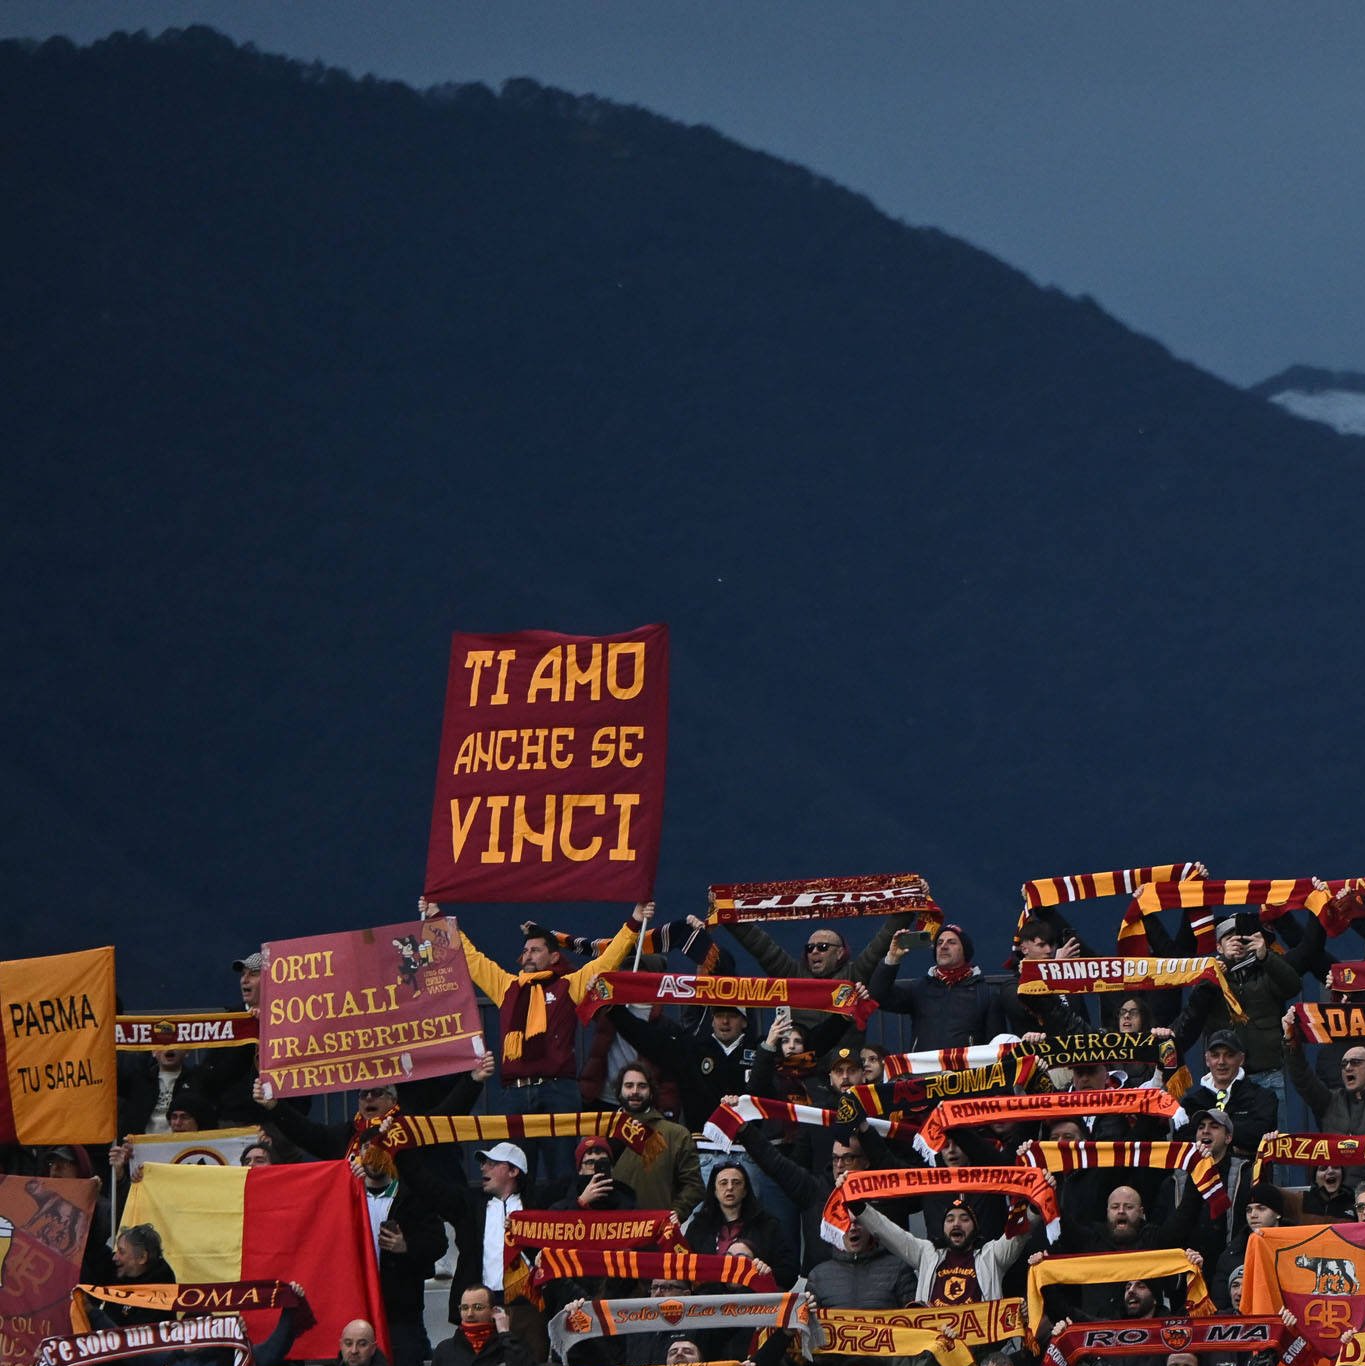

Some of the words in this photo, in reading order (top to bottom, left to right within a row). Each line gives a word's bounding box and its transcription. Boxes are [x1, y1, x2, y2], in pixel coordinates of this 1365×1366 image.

[464, 649, 517, 707] TI
[526, 642, 646, 703] AMO
[453, 727, 575, 776] ANCHE
[590, 726, 644, 767] SE
[449, 792, 640, 865] VINCI
[271, 950, 335, 984] ORTI
[1037, 958, 1148, 981] FRANCESCO
[1155, 956, 1210, 977] TOTTI
[10, 994, 100, 1038] PARMA
[269, 983, 403, 1026] SOCIALI
[176, 1020, 235, 1042] ROMA
[268, 1013, 465, 1058] TRASFERTISTI
[1055, 1032, 1157, 1052] VERONA
[1044, 1047, 1135, 1064] TOMMASI
[16, 1064, 48, 1091] TU
[269, 1058, 405, 1093] VIRTUALI
[925, 1067, 1006, 1100] ROMA
[950, 1096, 1007, 1116] ROMA
[1010, 1094, 1064, 1114] CLUB
[849, 1173, 903, 1193] ROMA
[908, 1170, 958, 1190] CLUB
[961, 1166, 1041, 1187] BRIANZA
[590, 1217, 655, 1239] INSIEME
[615, 1307, 657, 1324] Solo
[687, 1303, 716, 1319] La
[719, 1300, 782, 1318] Roma
[81, 1330, 119, 1356] solo
[123, 1326, 154, 1348] un
